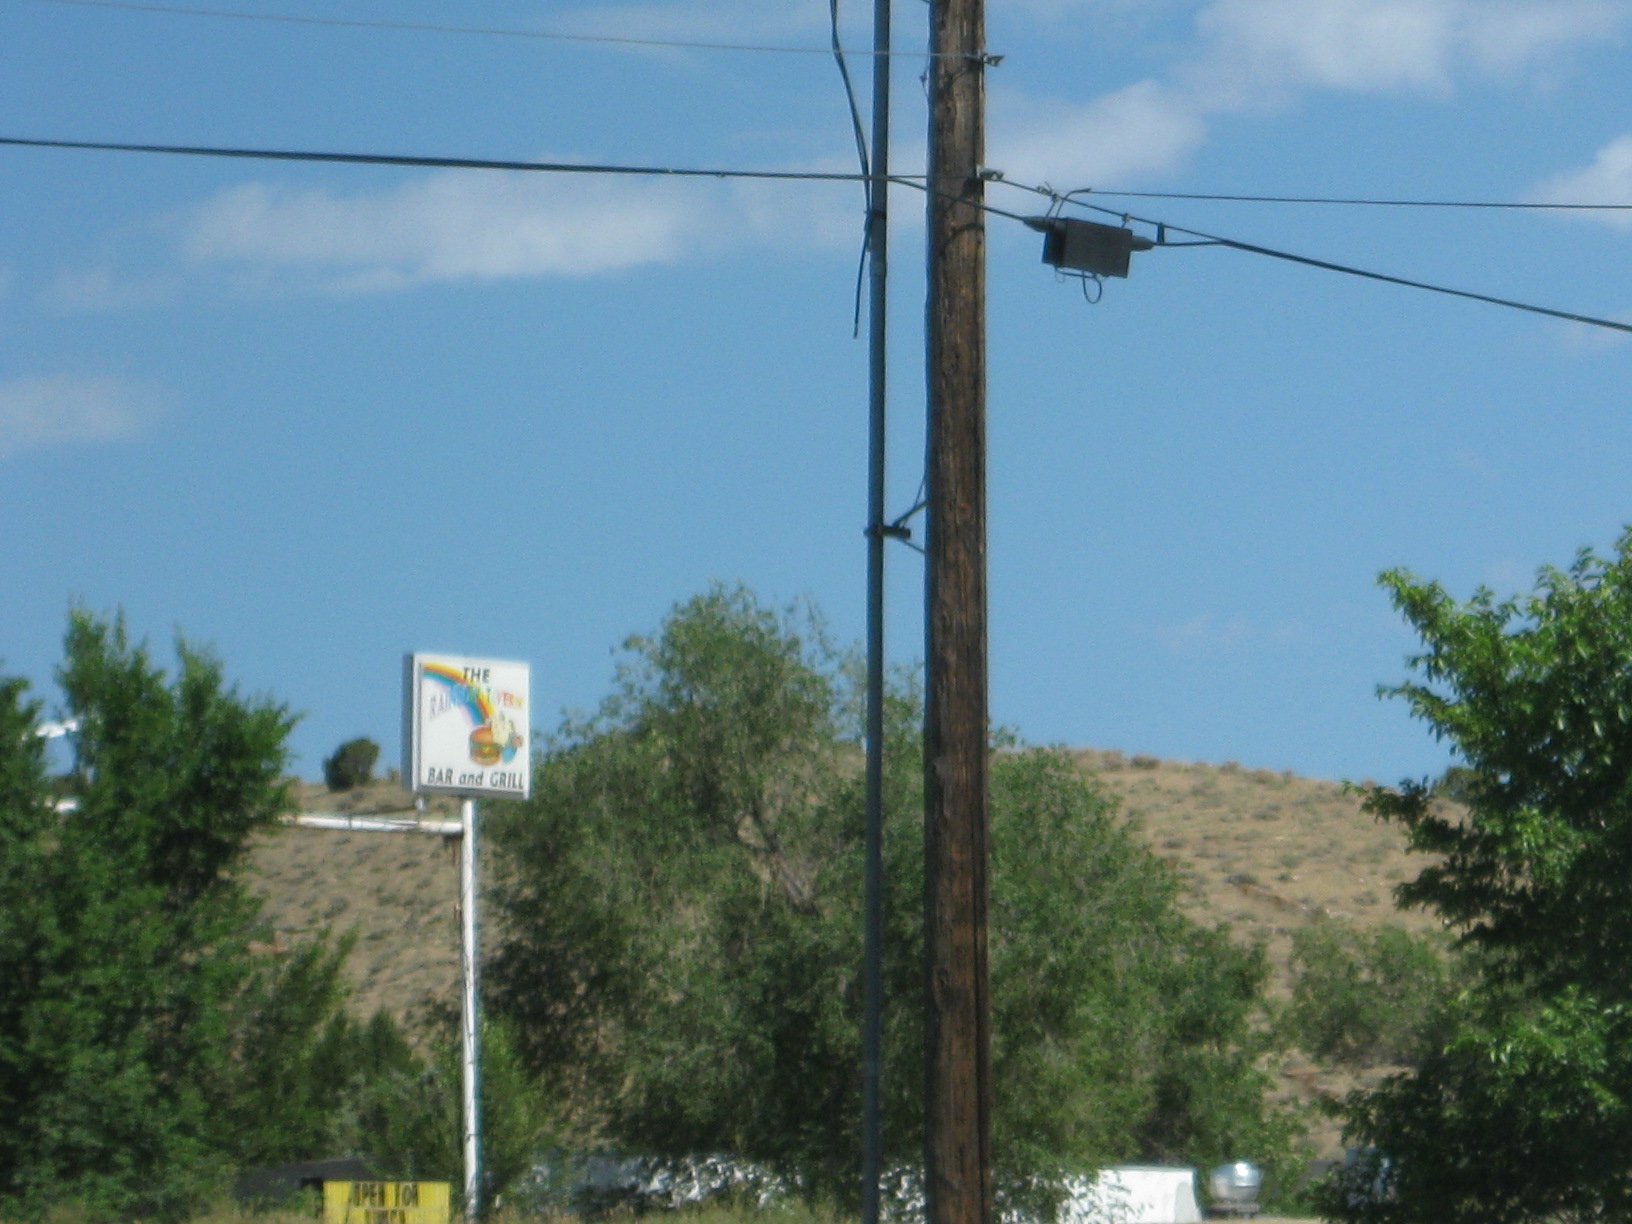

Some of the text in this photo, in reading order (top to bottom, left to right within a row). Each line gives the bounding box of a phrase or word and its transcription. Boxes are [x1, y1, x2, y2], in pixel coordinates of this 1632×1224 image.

[463, 666, 491, 684] THE
[486, 687, 524, 709] TVERN
[428, 767, 524, 790] BAR and GRILL
